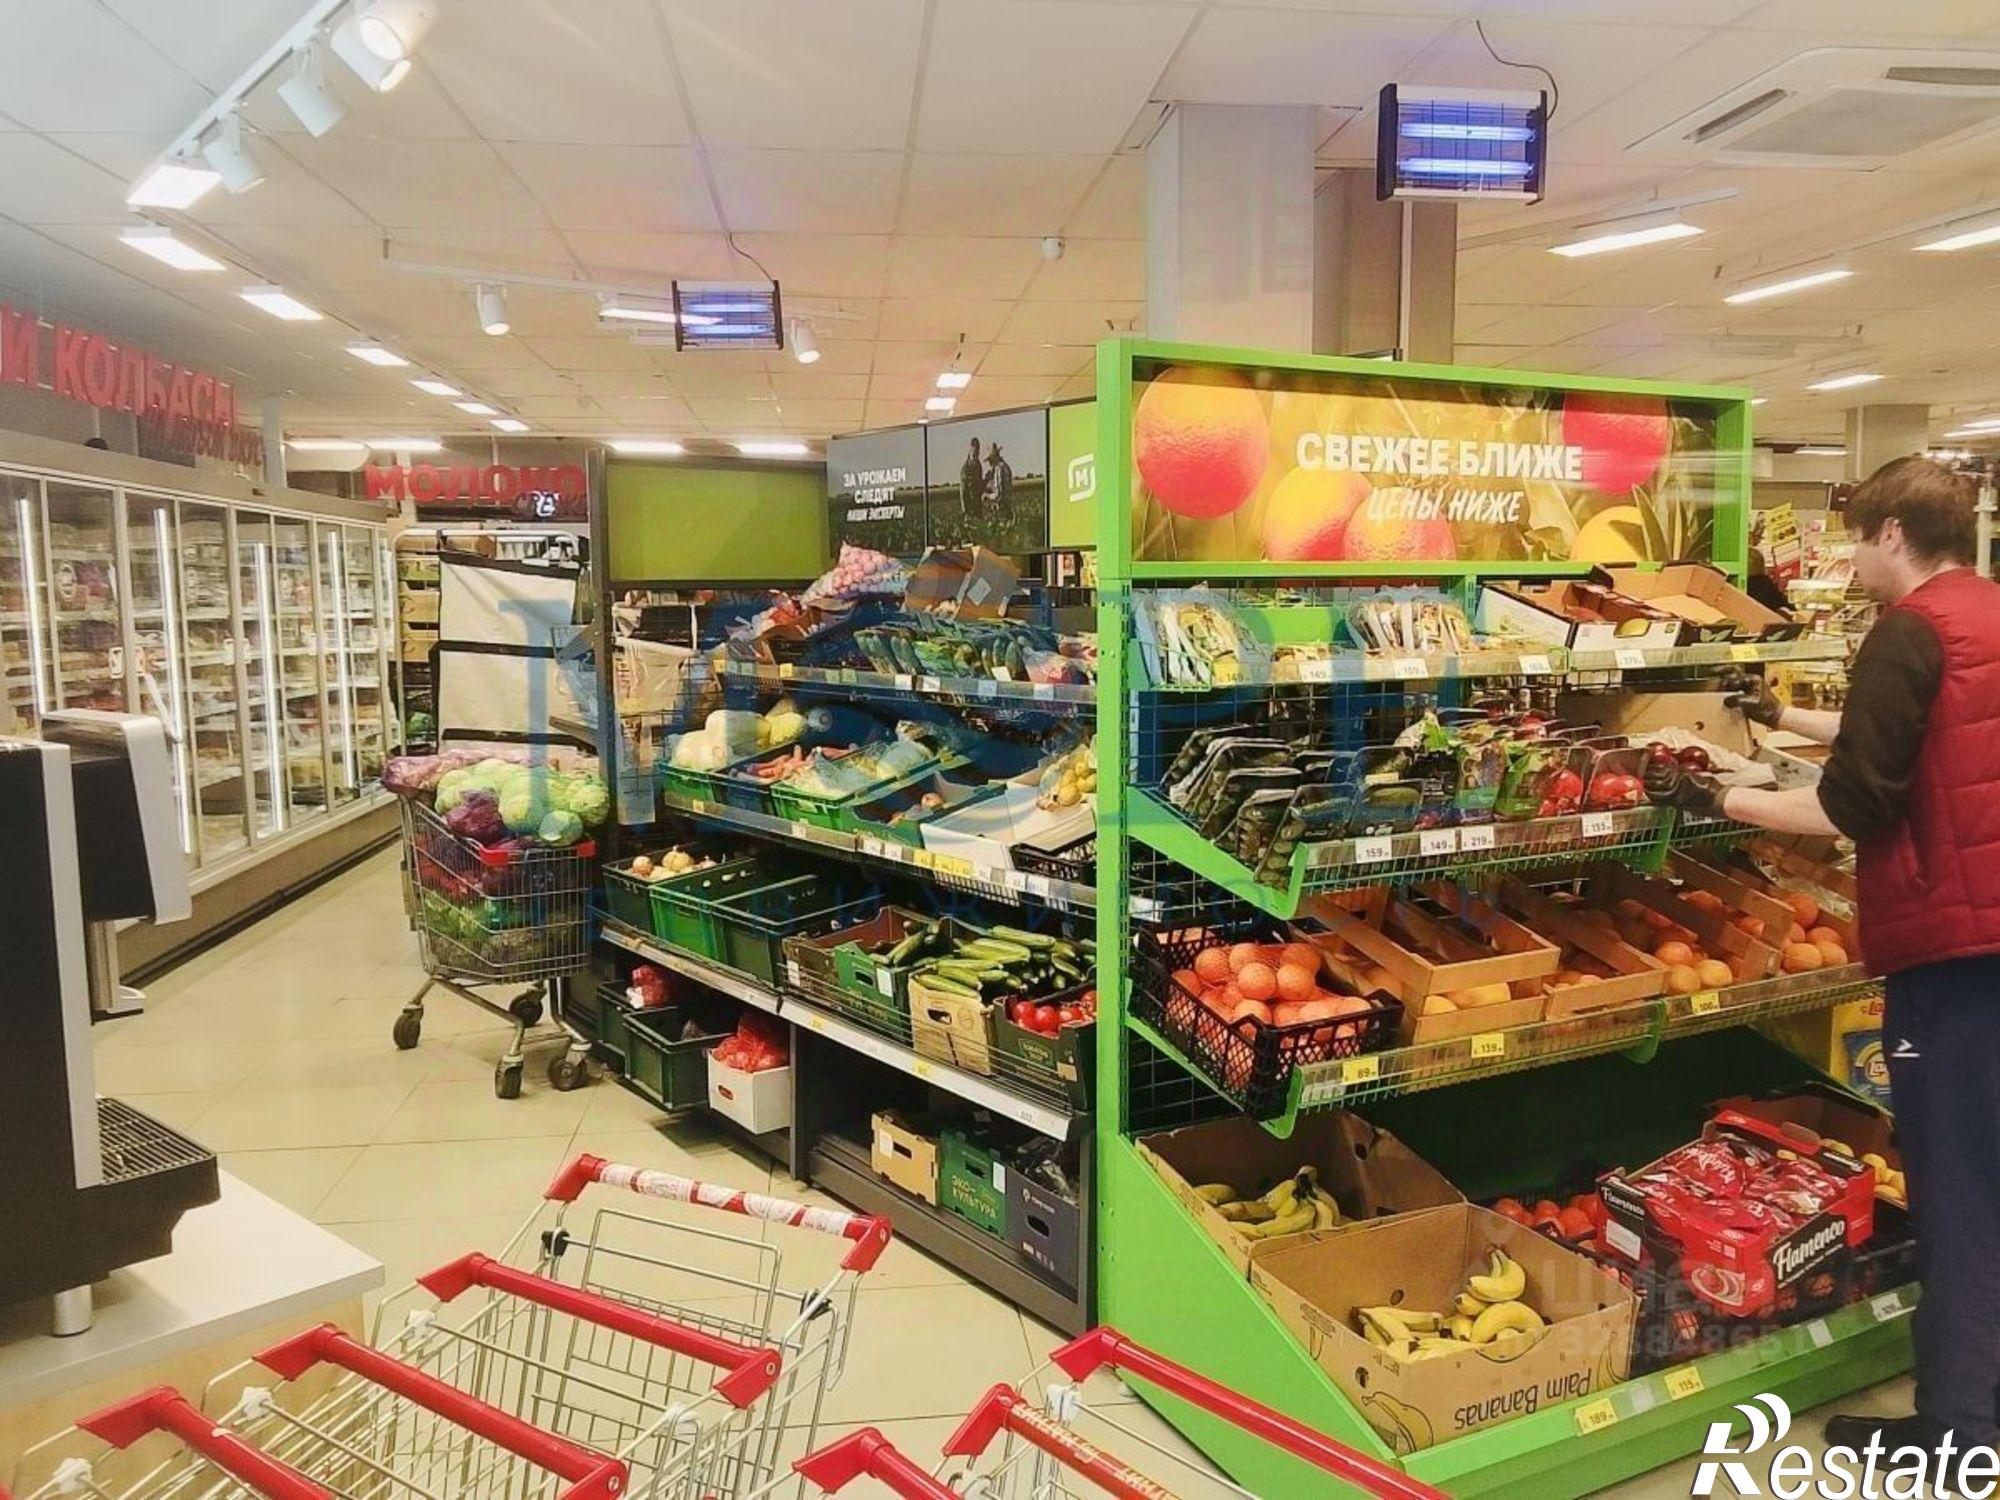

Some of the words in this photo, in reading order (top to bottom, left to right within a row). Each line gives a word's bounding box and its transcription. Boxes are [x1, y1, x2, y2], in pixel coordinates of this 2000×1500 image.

[54, 322, 239, 427] КОЛБАСЫ
[1296, 432, 1449, 475] СВЕЖЕЕ
[1459, 439, 1583, 481] БЛИЖЕ
[364, 463, 587, 503] МОЛОКО
[842, 472, 857, 487] ЗА
[857, 467, 906, 487] УРОЖАЕМ
[854, 486, 895, 505] СЛЕДЯТ
[1366, 486, 1446, 521] ЦЕНЫ
[1447, 490, 1525, 524] НИЖЕ
[1366, 847, 1383, 857] 159
[1430, 840, 1448, 850] 149
[1773, 1219, 1845, 1280] Flamenco
[1545, 1367, 1592, 1400] Palm
[1454, 1384, 1538, 1431] Bananas
